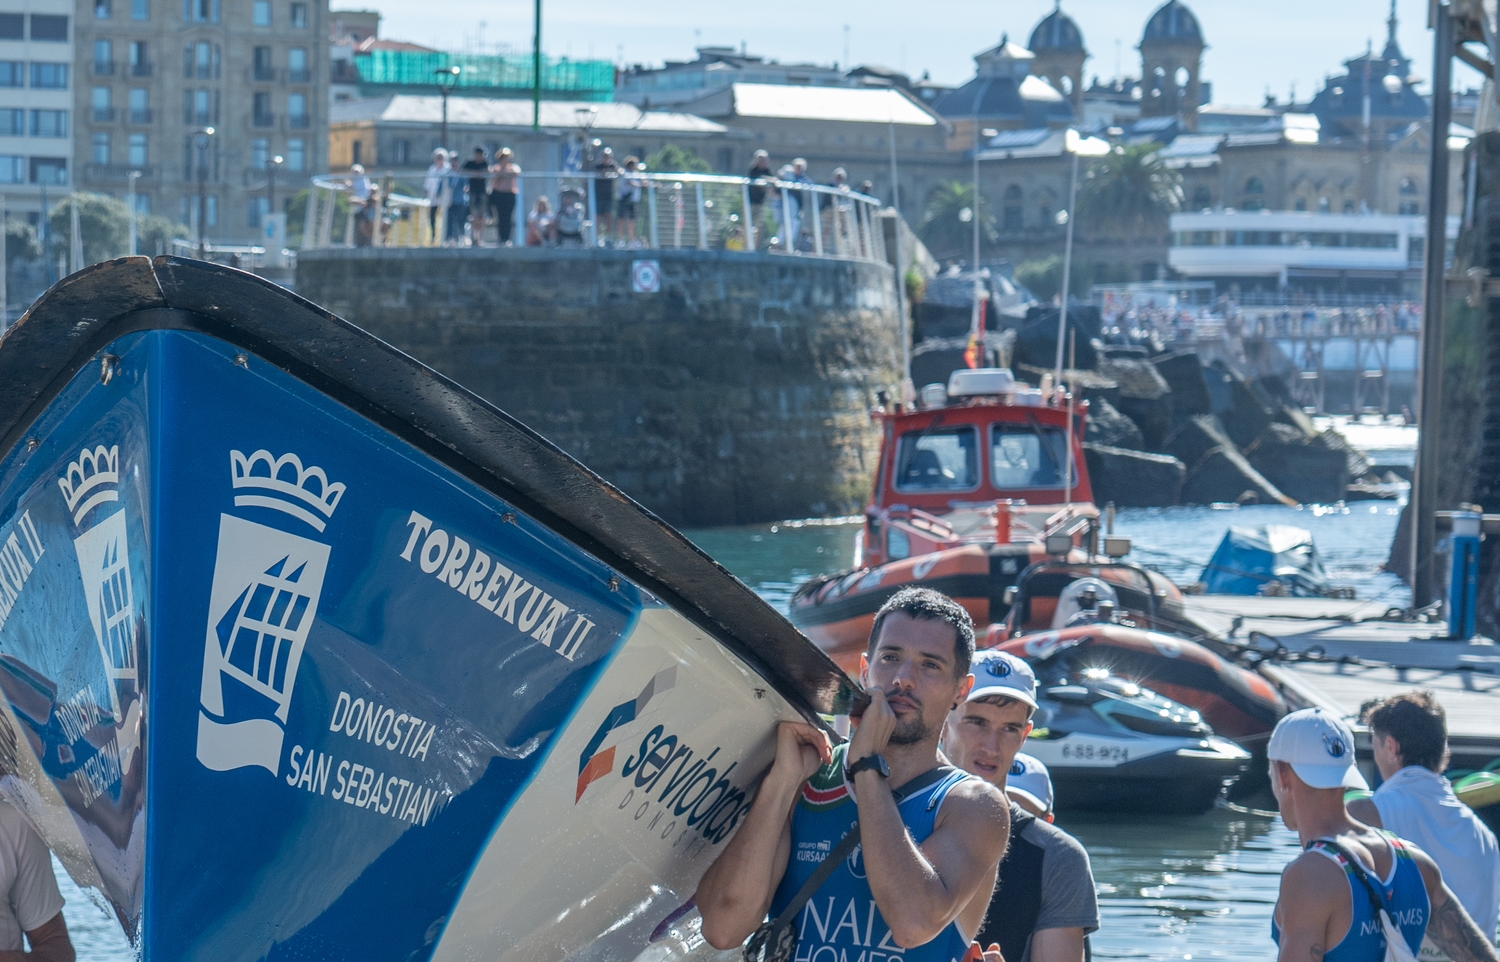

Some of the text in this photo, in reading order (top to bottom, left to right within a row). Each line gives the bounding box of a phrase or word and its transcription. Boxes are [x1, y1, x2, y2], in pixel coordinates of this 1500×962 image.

[18, 509, 45, 564] II
[400, 510, 596, 662] TORREKUA II
[330, 691, 436, 762] DONOSTIA
[286, 745, 438, 827] SAN SEBASTIAN
[797, 850, 830, 863] KURSAA
